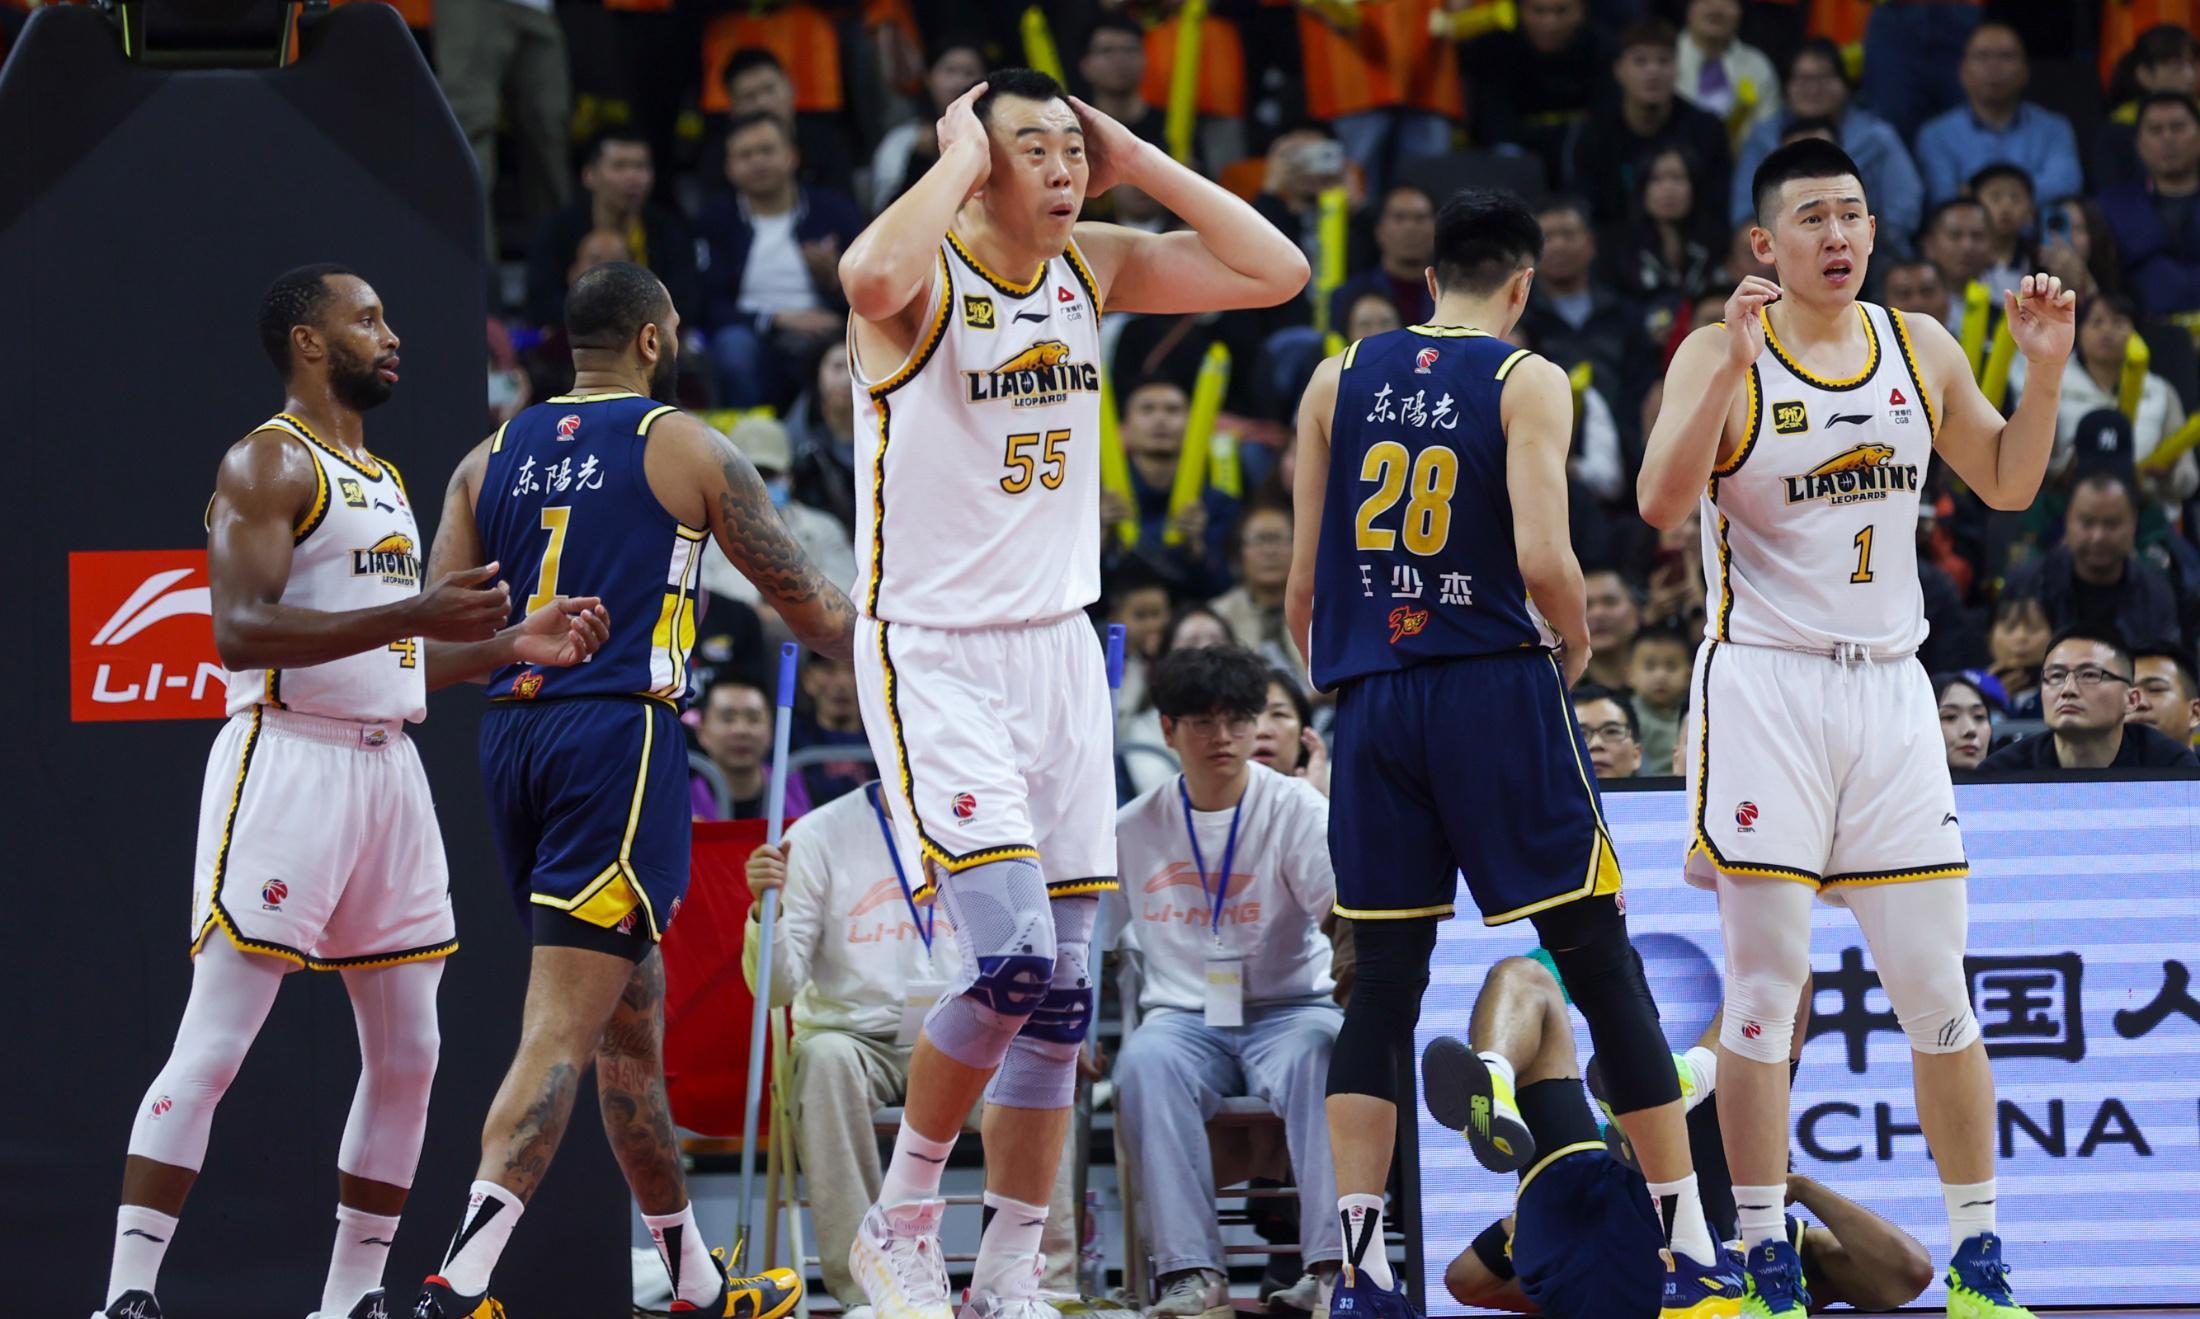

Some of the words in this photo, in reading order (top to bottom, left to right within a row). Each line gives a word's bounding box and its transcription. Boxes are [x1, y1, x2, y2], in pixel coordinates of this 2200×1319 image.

[967, 363, 1099, 400] LIAONING
[1014, 393, 1067, 407] LEOPARDS
[1000, 428, 1071, 494] 55
[1355, 440, 1458, 557] 28
[1784, 465, 1918, 503] LIAONING
[1831, 491, 1886, 505] LEOPARDS
[526, 505, 572, 616] 1
[1850, 525, 1873, 584] 1
[1143, 901, 1261, 927] LI-NNG
[1795, 1097, 2153, 1162] CHNA
[1339, 1297, 1354, 1310] 33
